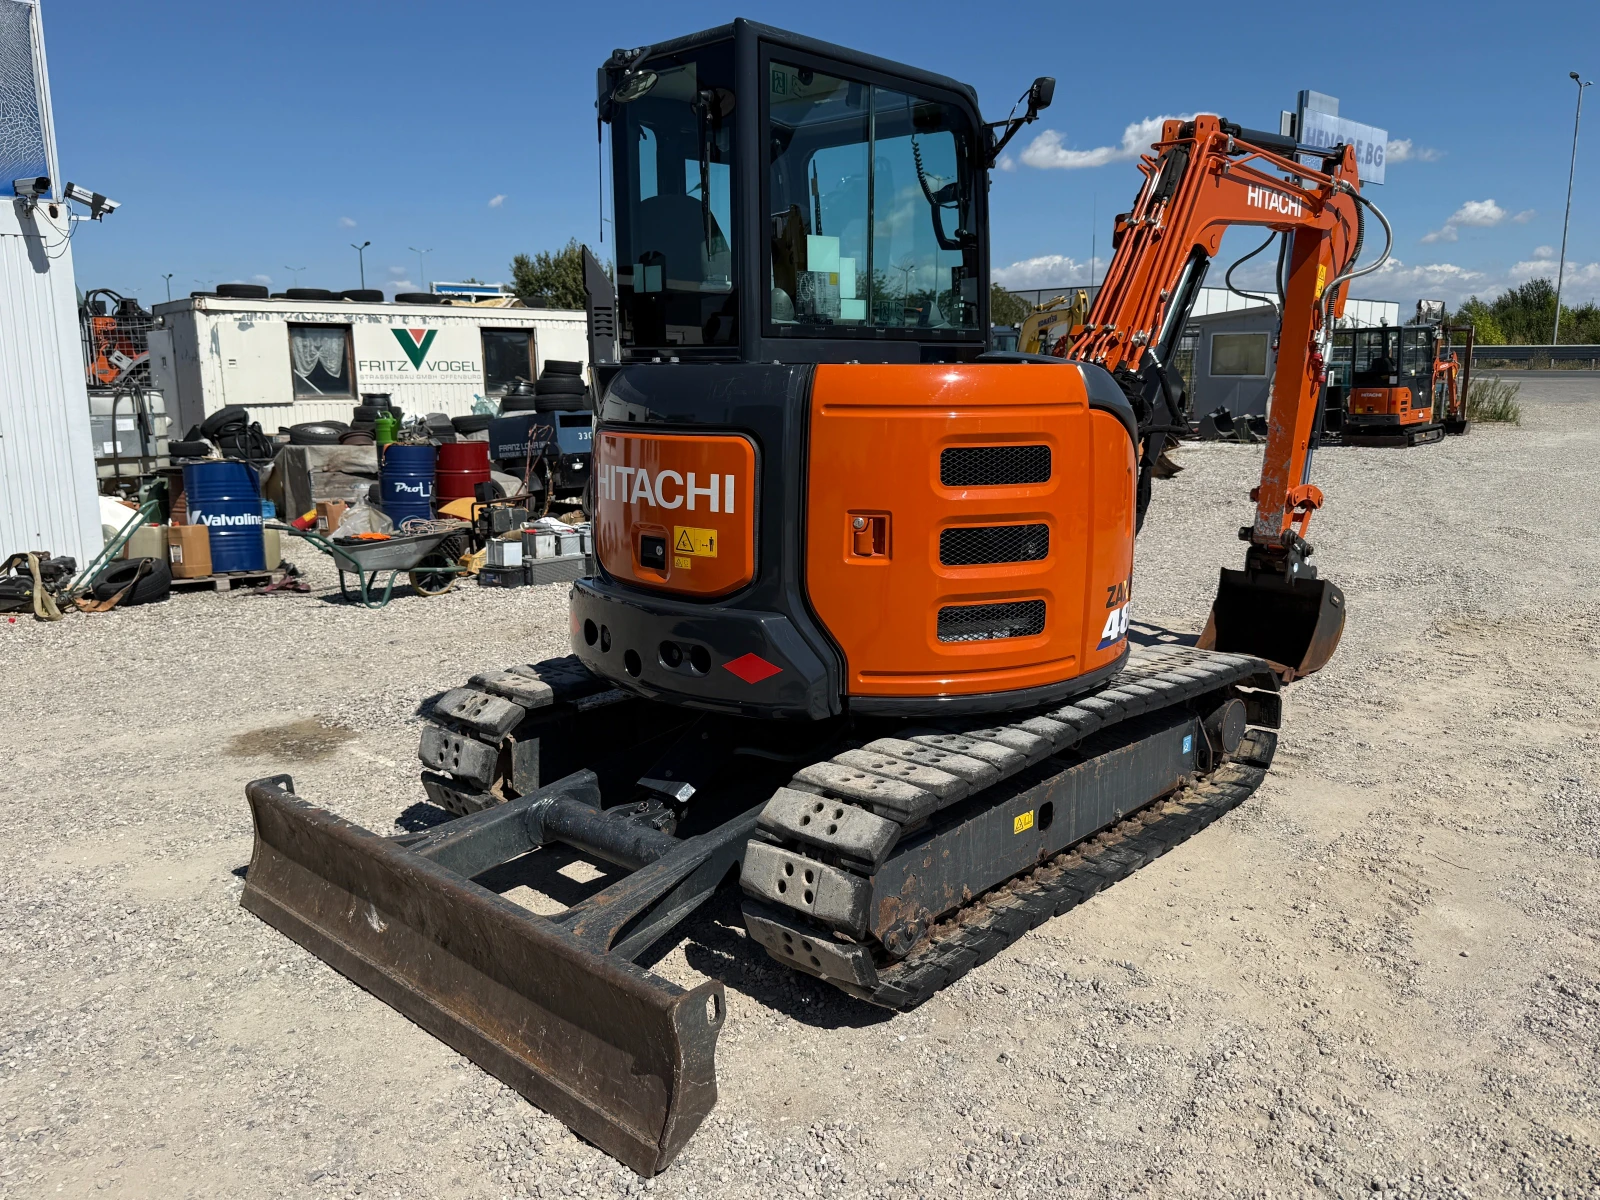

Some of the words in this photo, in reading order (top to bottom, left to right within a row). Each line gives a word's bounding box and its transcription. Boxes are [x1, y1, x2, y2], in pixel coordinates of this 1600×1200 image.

[1247, 184, 1302, 217] HITACHI
[1038, 314, 1057, 328] KOMATSU
[358, 360, 409, 372] FRITZ
[426, 360, 481, 372] VOGEL
[499, 444, 520, 452] FRANZ
[598, 463, 735, 514] HITACHI
[201, 513, 262, 527] Valvoline
[1102, 601, 1130, 640] 48
